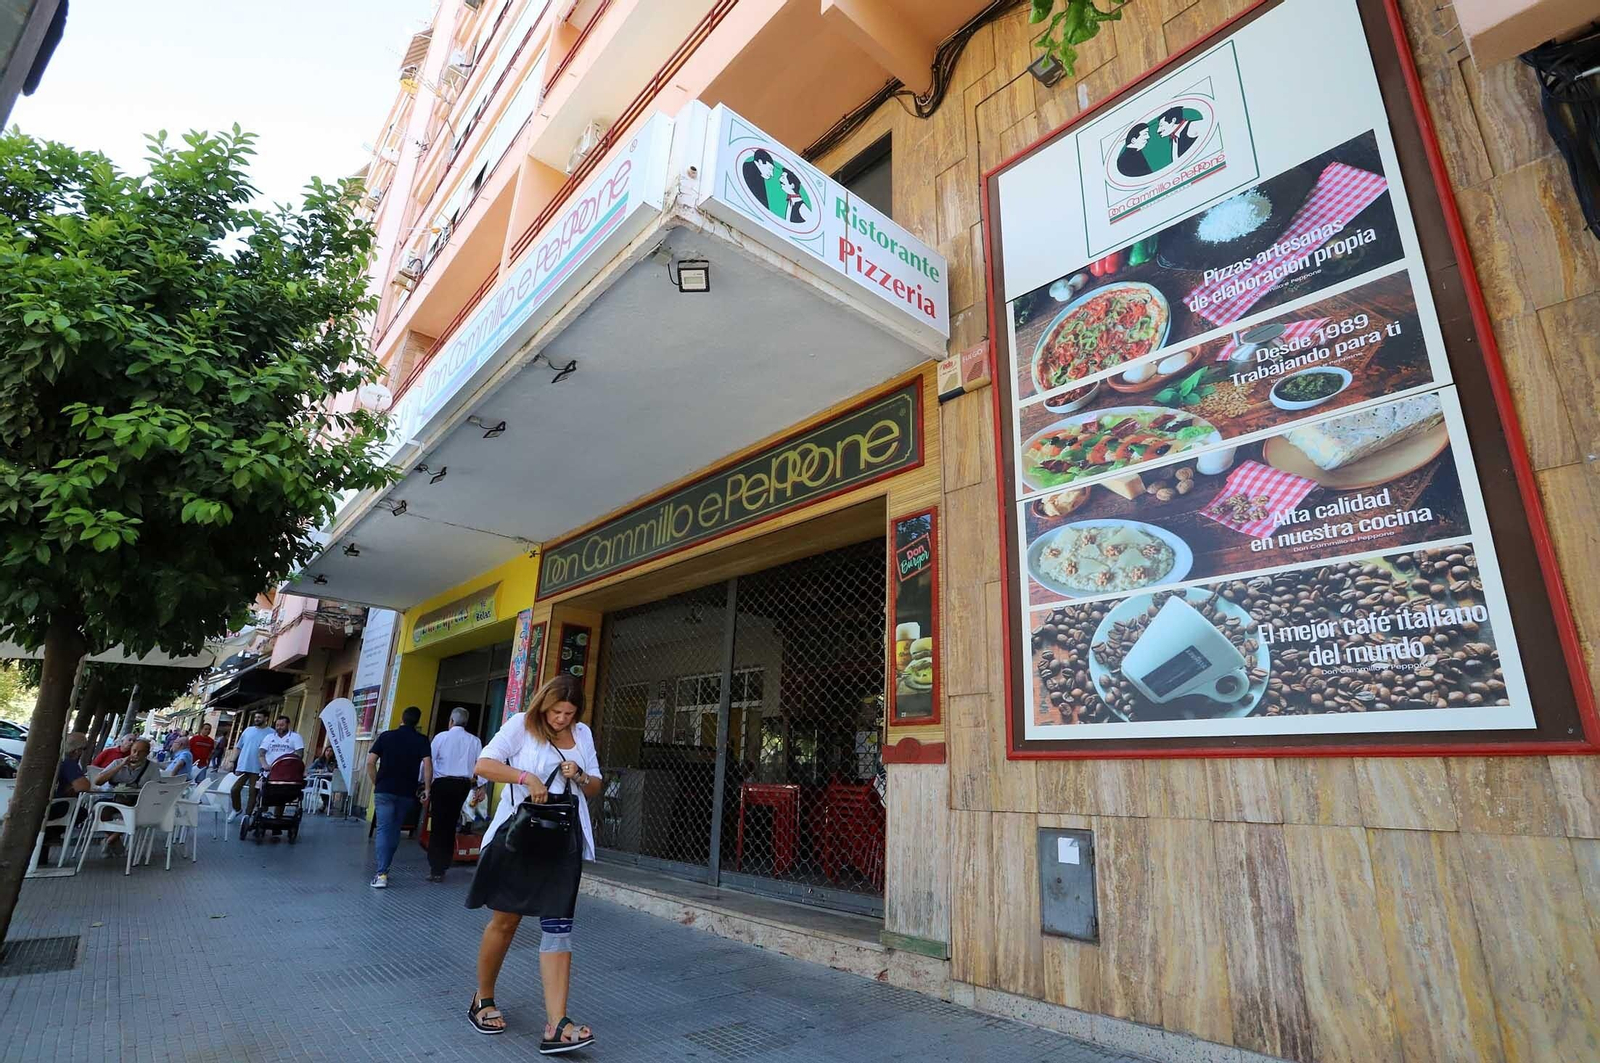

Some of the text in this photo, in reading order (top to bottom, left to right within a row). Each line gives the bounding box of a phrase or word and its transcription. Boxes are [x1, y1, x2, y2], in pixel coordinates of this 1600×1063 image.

[1126, 181, 1171, 208] Cammillo
[1172, 176, 1180, 186] e
[835, 196, 940, 284] Ristorante
[1202, 218, 1345, 287] Pizzas artesanas
[517, 272, 532, 299] e
[838, 236, 937, 319] Pizzeria
[1189, 227, 1377, 313] de elaboración propia
[1290, 269, 1322, 284] Peppone
[1230, 346, 1330, 387] Trabajando
[1335, 329, 1382, 357] para
[1386, 320, 1402, 337] ti
[1256, 313, 1370, 364] Desde 1989
[582, 503, 693, 572] Cammillo
[699, 492, 722, 527] e
[724, 418, 900, 521] Peppone
[1272, 488, 1391, 528] Alta calidad
[1250, 506, 1433, 553] en nuestra cocina
[1310, 539, 1349, 550] Cammillo
[1358, 531, 1395, 541] Peppone
[900, 550, 930, 574] Burger
[907, 544, 925, 560] Don
[1257, 604, 1488, 645] El mejor café italiano
[1308, 636, 1425, 667] del mundo
